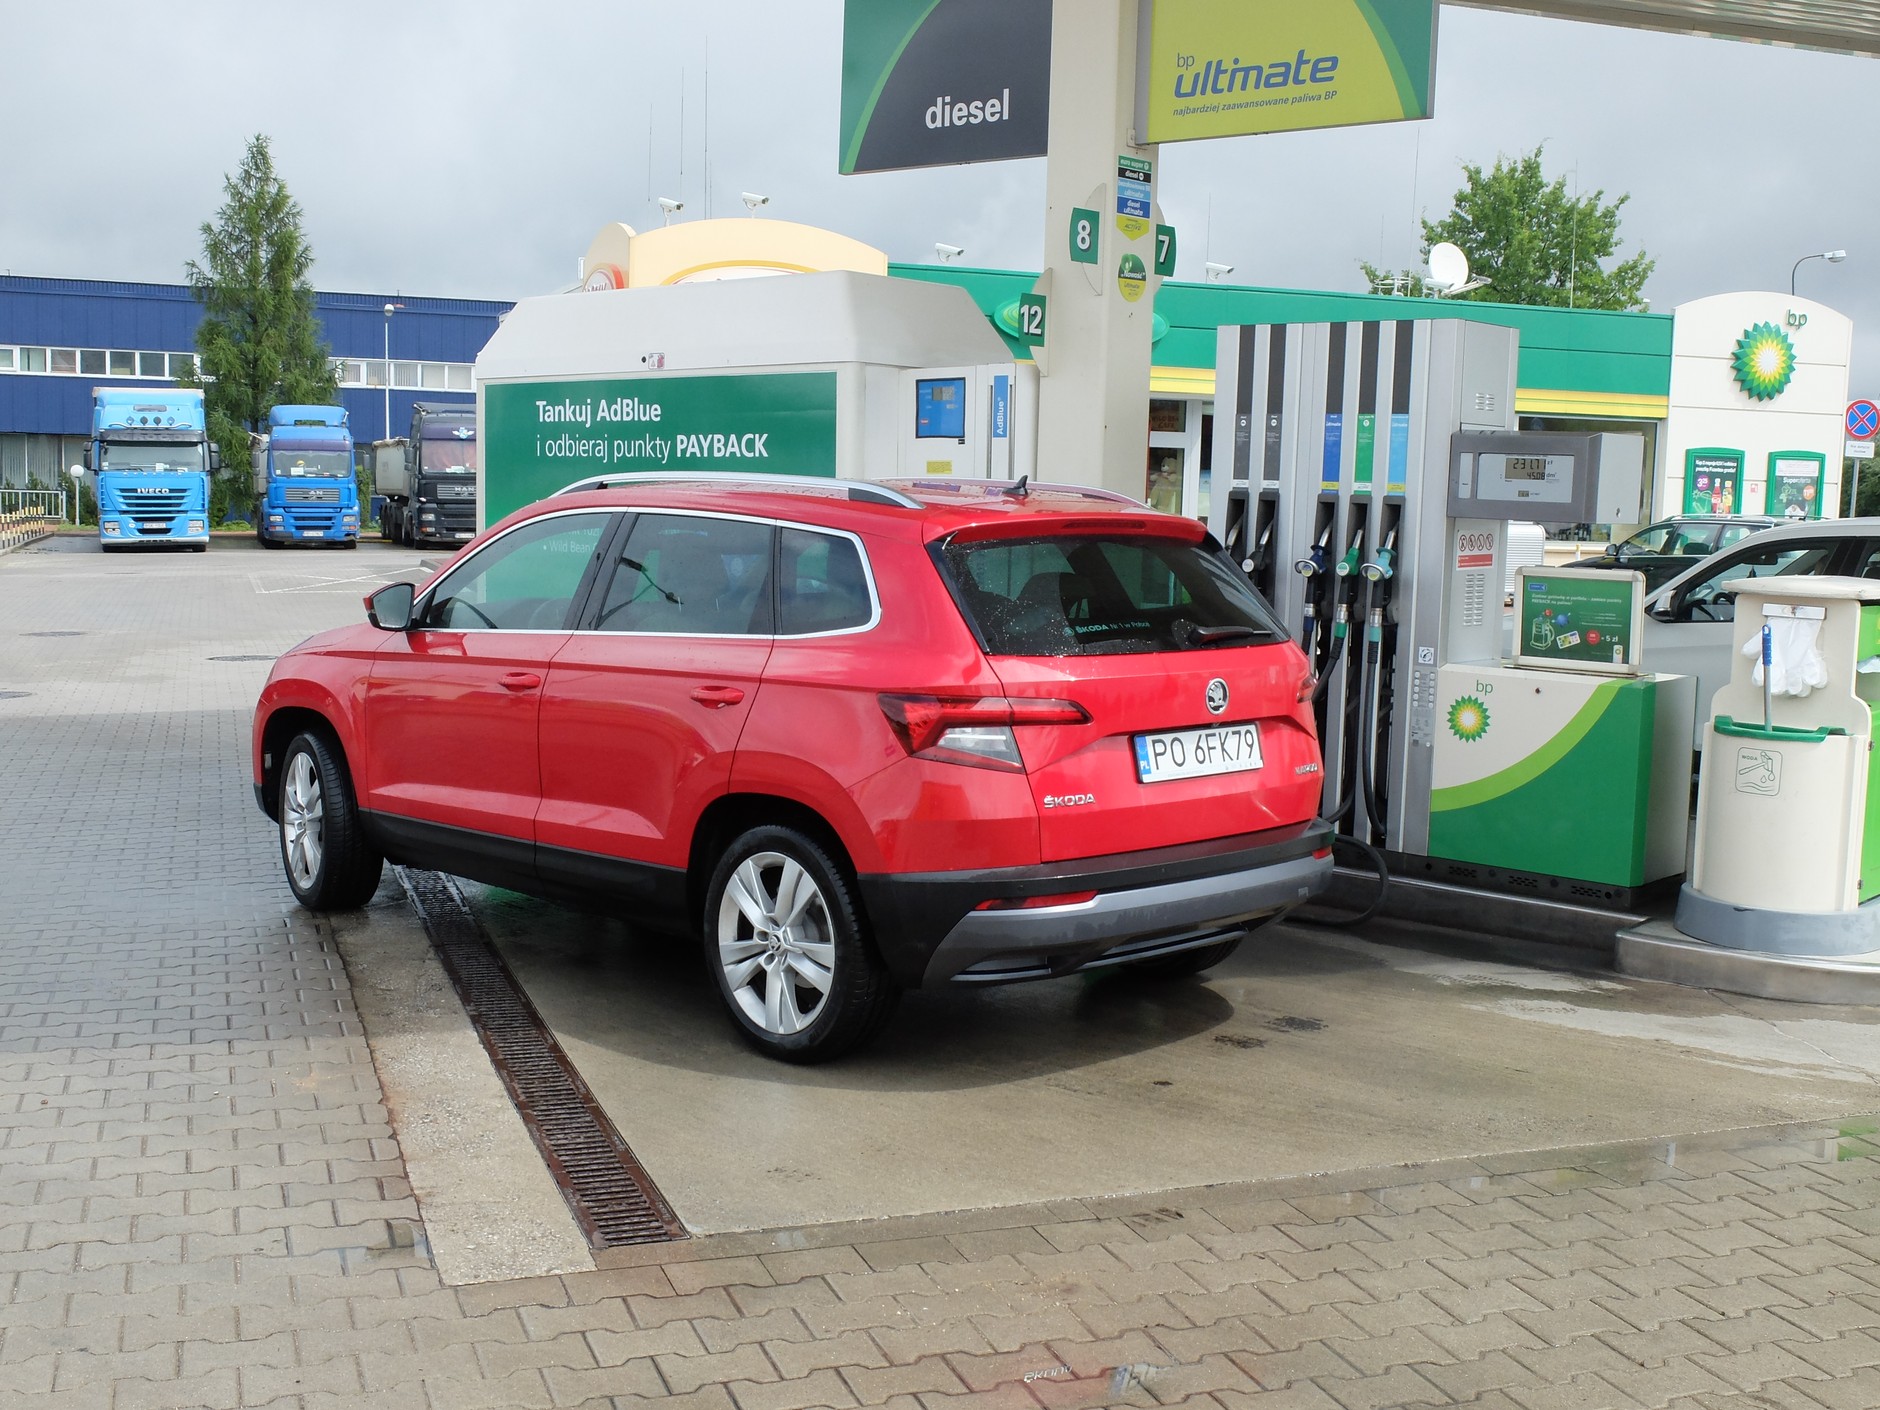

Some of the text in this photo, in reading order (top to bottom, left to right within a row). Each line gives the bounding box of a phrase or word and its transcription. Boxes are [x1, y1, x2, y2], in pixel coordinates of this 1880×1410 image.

[1177, 53, 1195, 70] bp
[1174, 49, 1339, 98] ultimate
[925, 88, 1009, 129] diesel
[1173, 90, 1338, 117] najbardziej zaawansowane paliwa BP
[1125, 170, 1139, 179] diesel
[1123, 207, 1144, 216] ultimate
[1127, 200, 1141, 208] diesel
[1077, 220, 1091, 250] 8
[1158, 235, 1170, 263] 7
[1021, 304, 1043, 335] 12
[1786, 309, 1808, 328] bp
[536, 397, 661, 428] Tankuj AdBlue
[537, 433, 769, 464] i odbieraj punkty PAYBACK
[549, 540, 591, 553] Wild Bean
[1075, 624, 1109, 634] ŠKODA
[1476, 680, 1494, 697] bp
[1152, 728, 1255, 770] PO 6FK79
[1140, 760, 1150, 770] PL
[1043, 793, 1096, 809] ŠKODA
